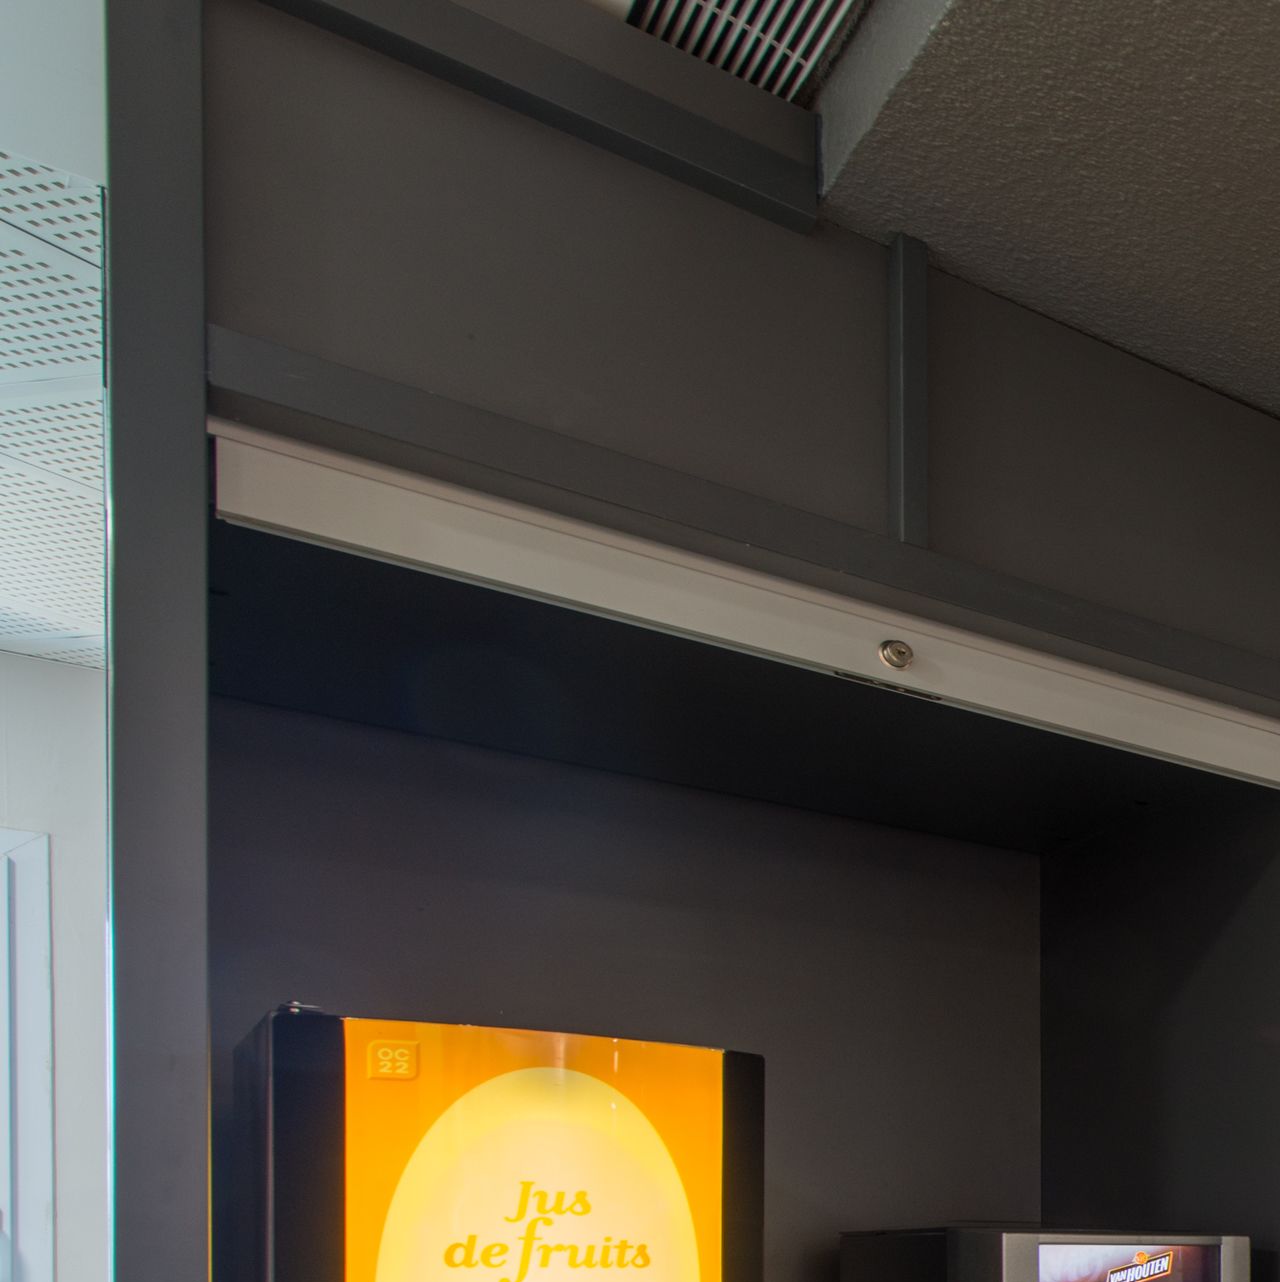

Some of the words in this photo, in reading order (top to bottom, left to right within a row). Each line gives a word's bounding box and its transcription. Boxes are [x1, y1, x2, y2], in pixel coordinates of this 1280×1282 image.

[377, 1047, 411, 1062] OC
[504, 1181, 592, 1222] Jus
[443, 1234, 509, 1269] de
[1126, 1256, 1169, 1282] HOUTEN
